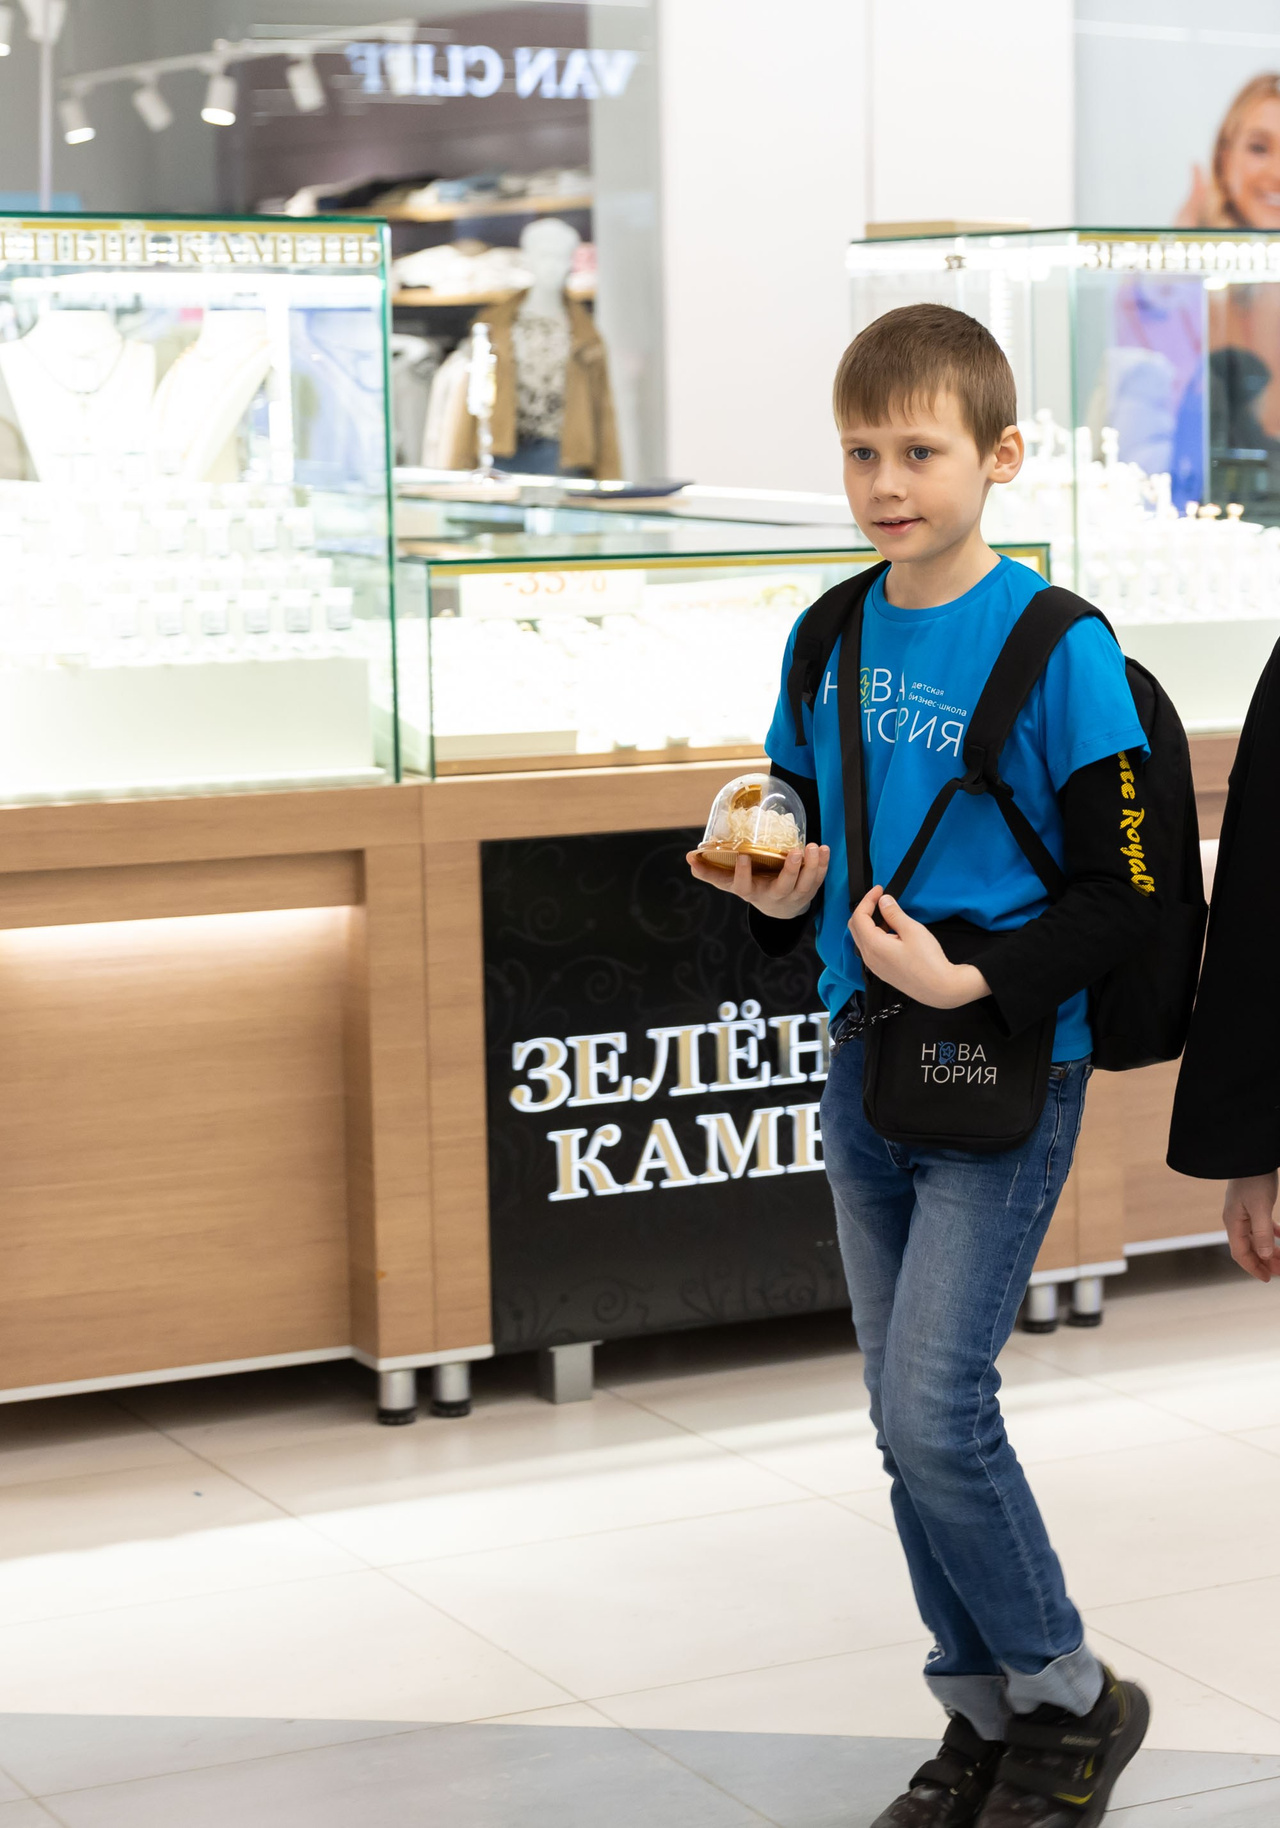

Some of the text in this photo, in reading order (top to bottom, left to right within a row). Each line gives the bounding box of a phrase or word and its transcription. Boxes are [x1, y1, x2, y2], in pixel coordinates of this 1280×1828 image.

[911, 681, 945, 697] детская
[908, 691, 967, 717] бизнес-школа
[863, 707, 964, 757] ТОРИЯ
[509, 998, 833, 1113] ЗЕЛЁН
[921, 1065, 998, 1085] ТОРИЯ
